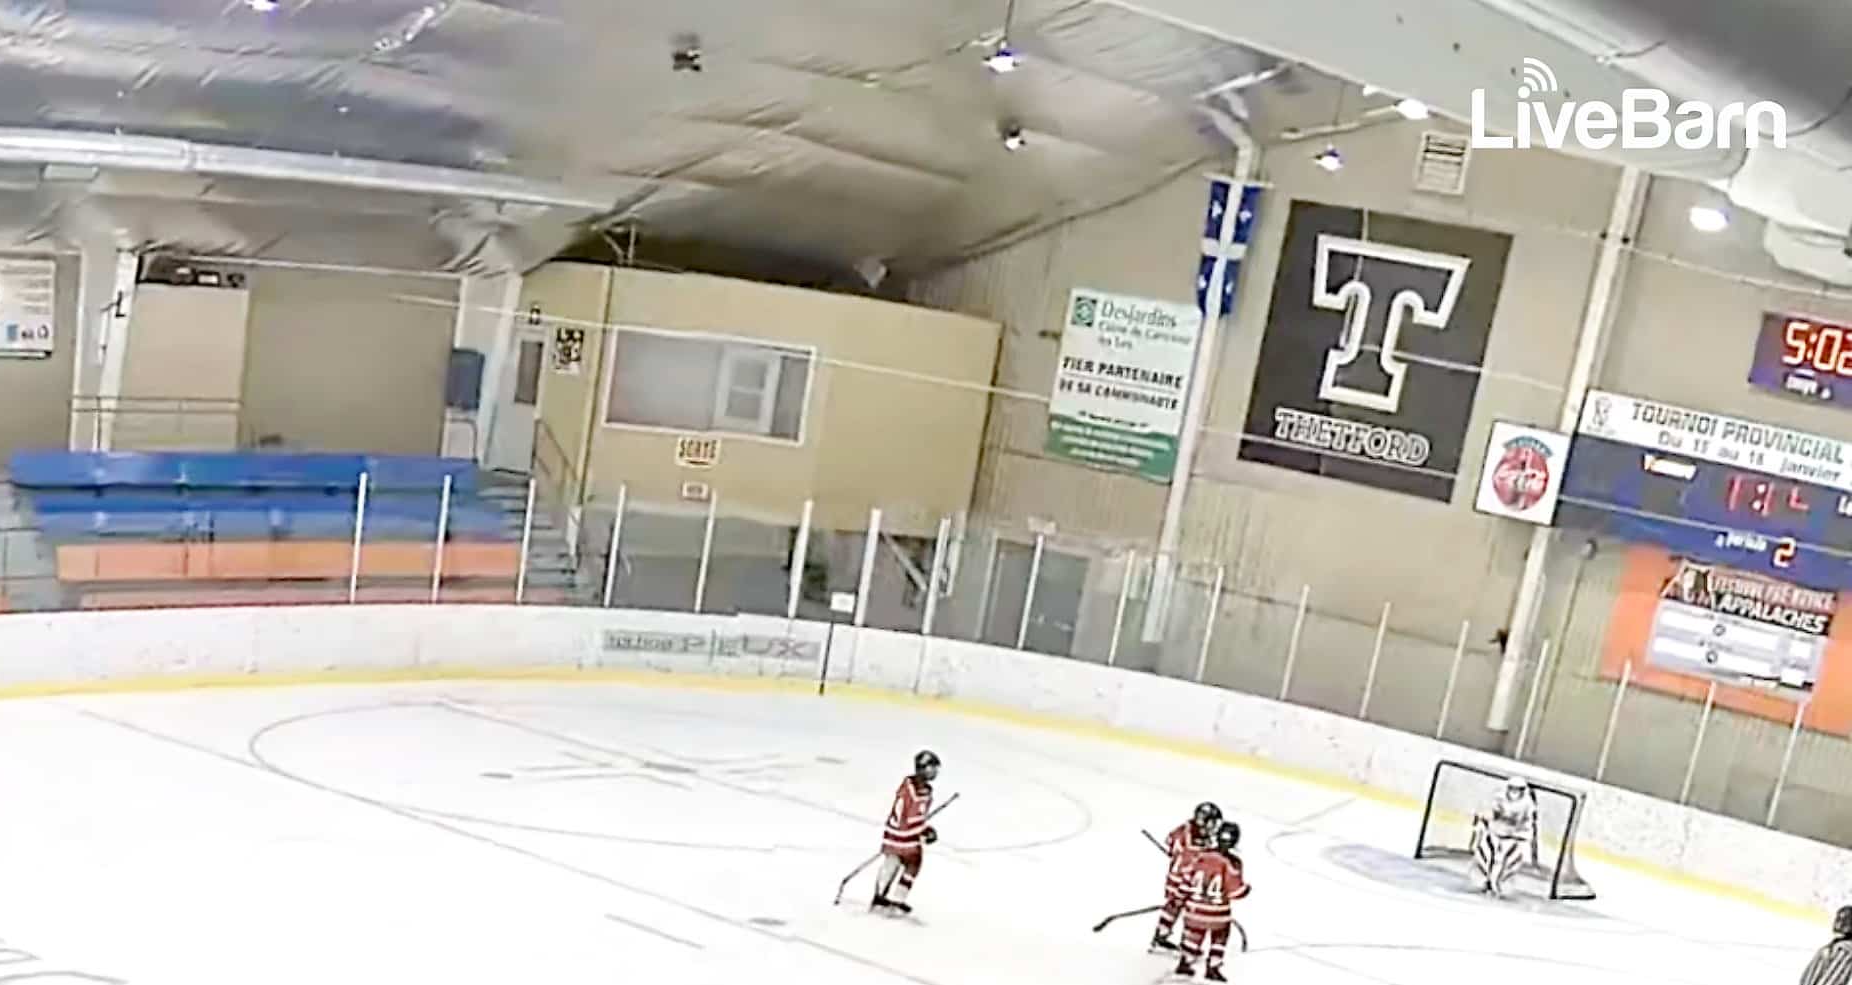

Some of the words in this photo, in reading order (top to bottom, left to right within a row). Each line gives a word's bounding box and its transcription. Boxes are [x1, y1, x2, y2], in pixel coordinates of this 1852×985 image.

[114, 290, 127, 318] L
[1101, 301, 1177, 328] Desjardins
[1313, 232, 1471, 412] T
[1097, 362, 1183, 389] PARTENAIRE
[1274, 407, 1430, 466] THETFORD
[1631, 403, 1718, 434] TOURNOI
[1721, 422, 1845, 465] PROVINCIAL
[1772, 536, 1797, 568] 2
[1717, 594, 1829, 632] APPALACHES
[1189, 869, 1224, 905] 44
